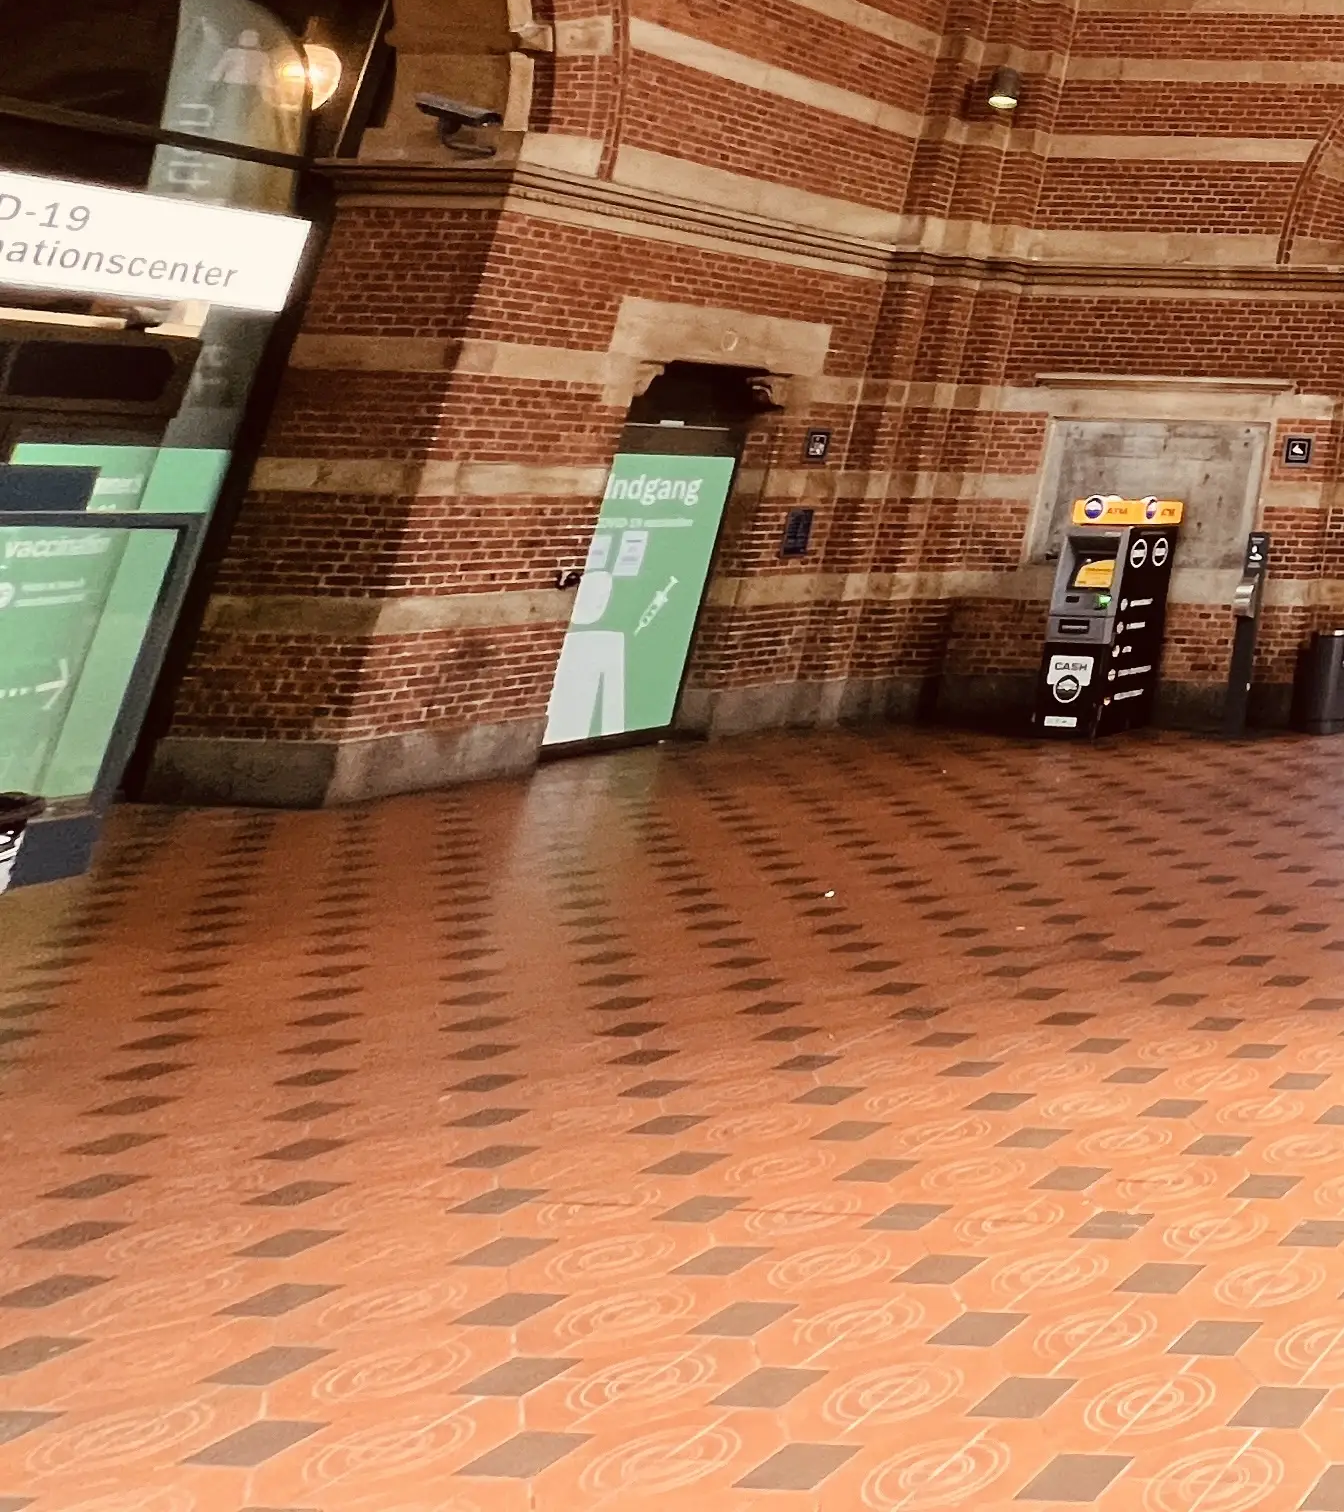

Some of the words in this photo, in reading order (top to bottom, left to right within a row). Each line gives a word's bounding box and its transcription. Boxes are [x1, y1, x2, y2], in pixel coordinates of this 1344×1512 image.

[0, 239, 239, 288] ationscenter
[604, 472, 704, 506] Indgang
[1054, 662, 1088, 672] CASH
